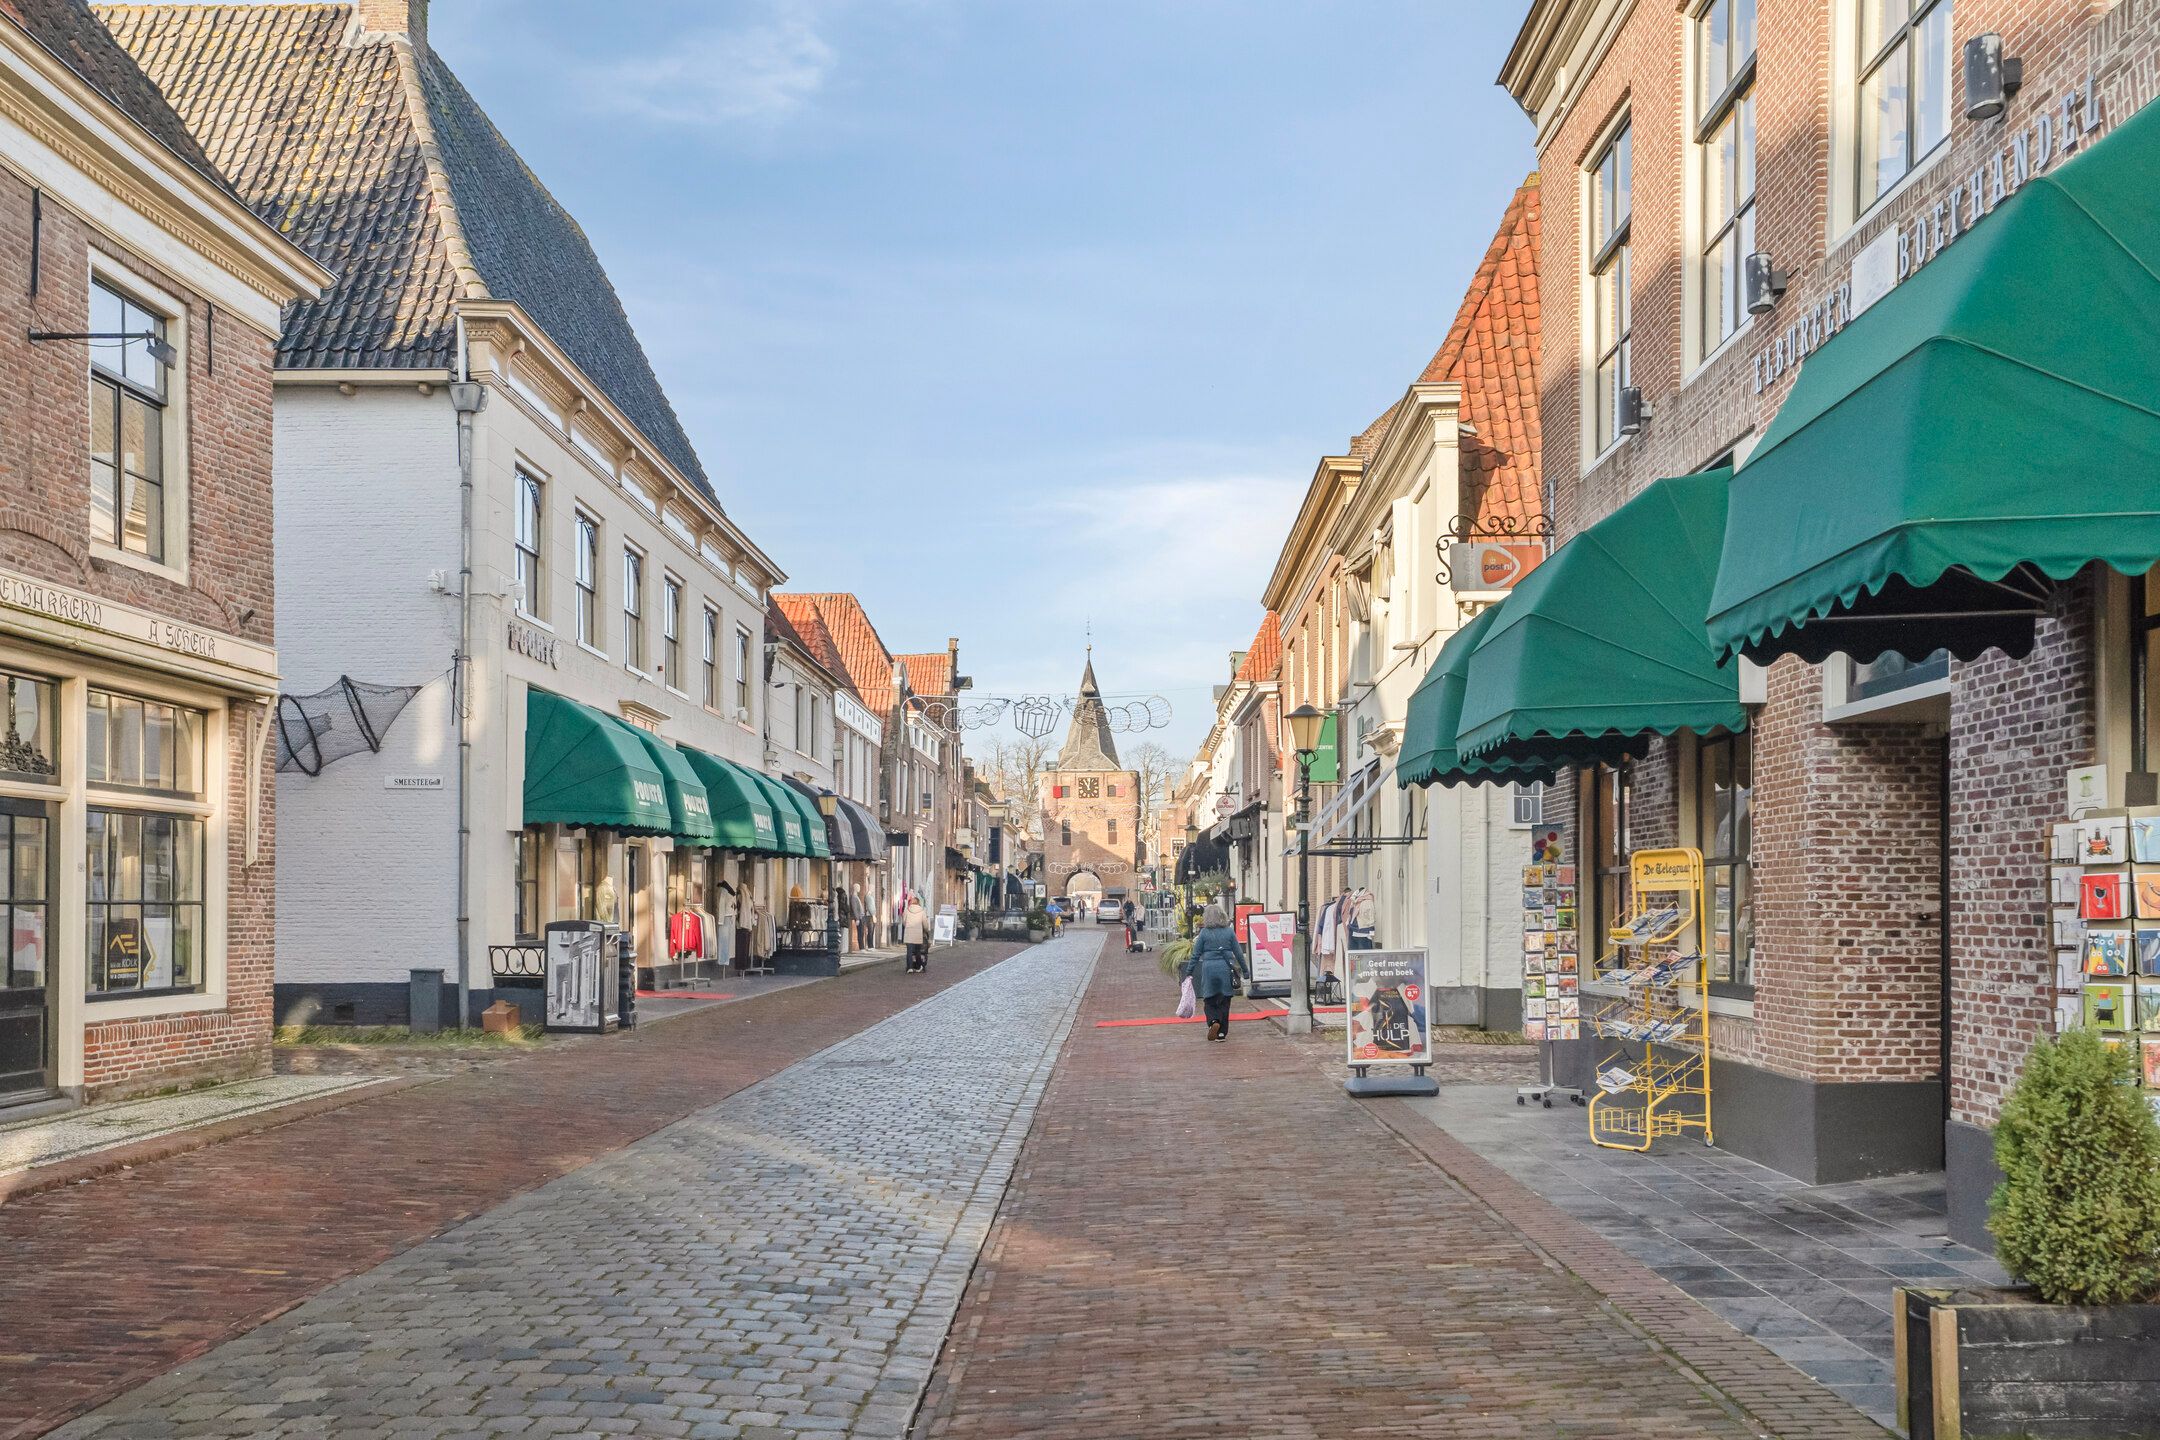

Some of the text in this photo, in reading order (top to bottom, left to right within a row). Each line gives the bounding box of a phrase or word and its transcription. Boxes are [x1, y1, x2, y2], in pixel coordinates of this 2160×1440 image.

[1752, 74, 2104, 395] ELBURGER BOEKHANDEL
[165, 625, 216, 658] SCHENK
[1643, 863, 1691, 875] De Telegraa
[1395, 968, 1414, 976] boek
[1393, 1022, 1405, 1030] DE
[1372, 1029, 1410, 1041] HULP
